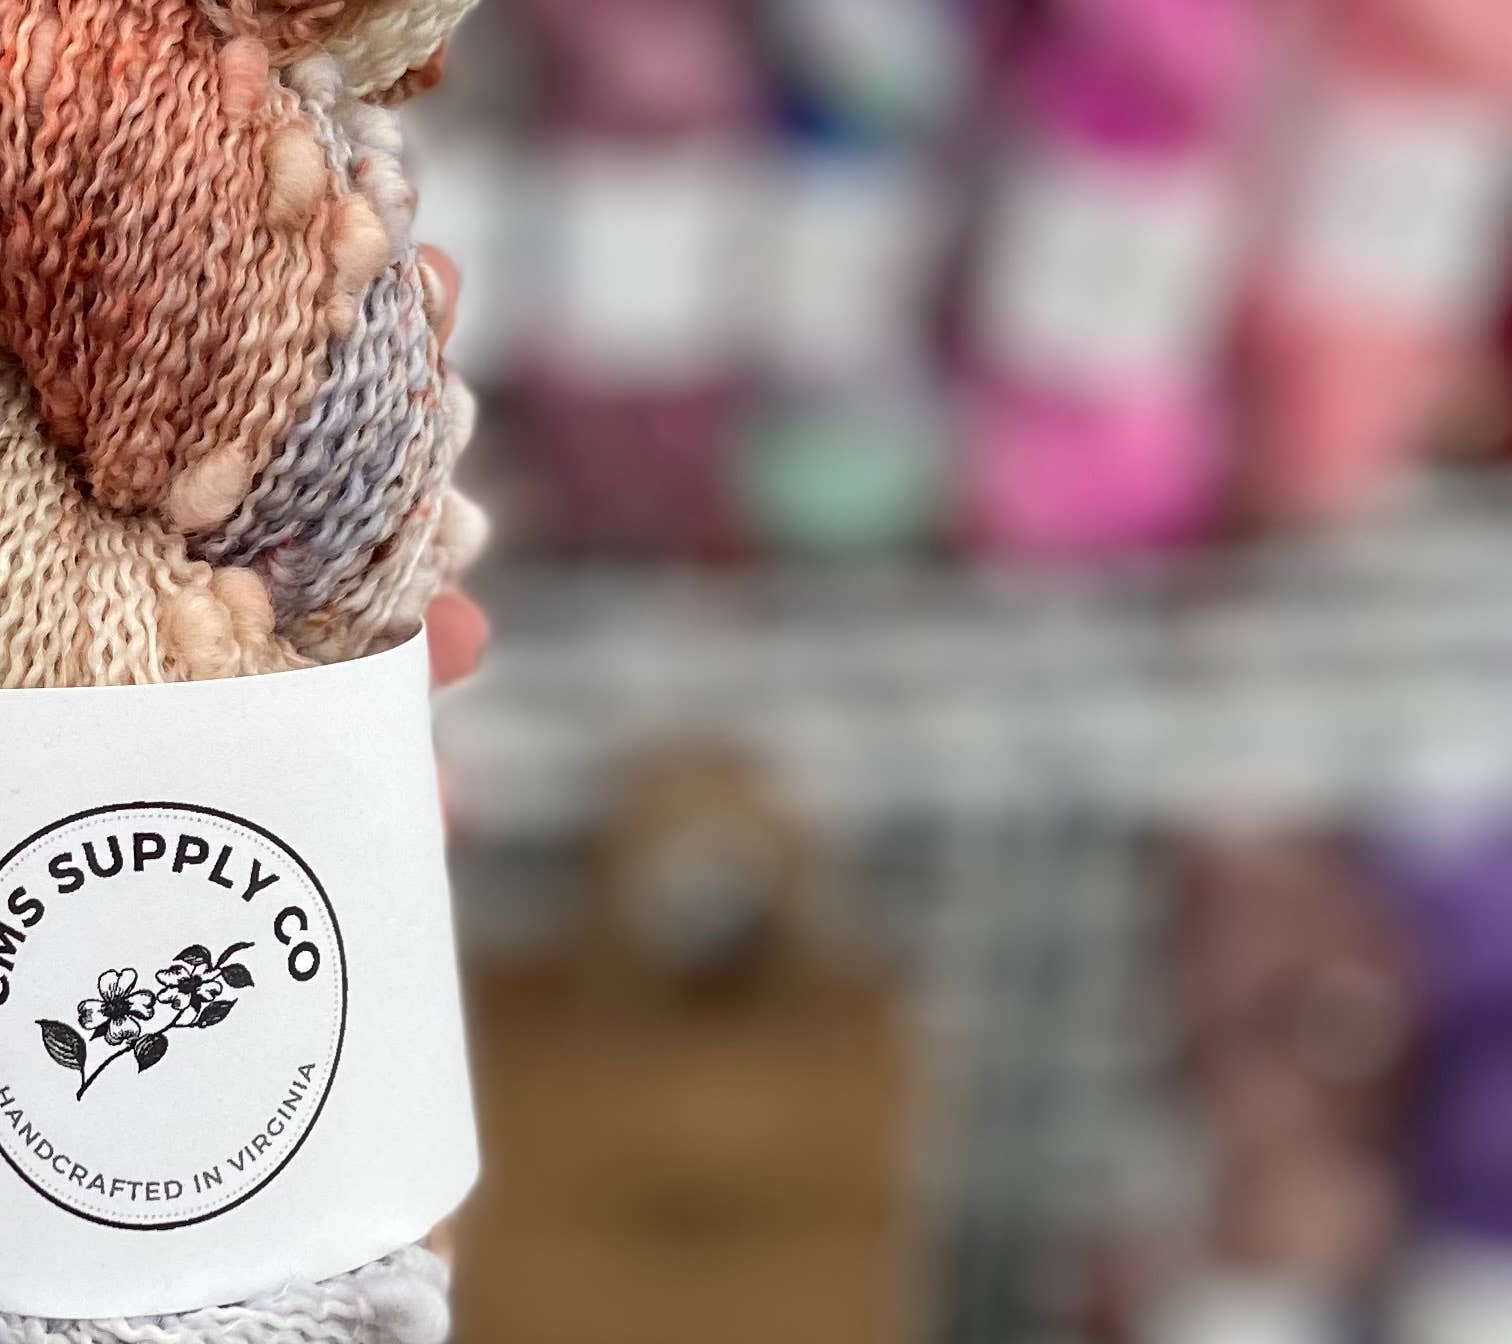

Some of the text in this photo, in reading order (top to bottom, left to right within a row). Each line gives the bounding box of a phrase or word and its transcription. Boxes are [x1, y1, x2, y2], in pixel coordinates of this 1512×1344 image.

[47, 831, 281, 903] SUPPLY
[273, 905, 321, 982] CO
[193, 1165, 223, 1194] IN
[226, 1060, 317, 1172] VIRGINIA
